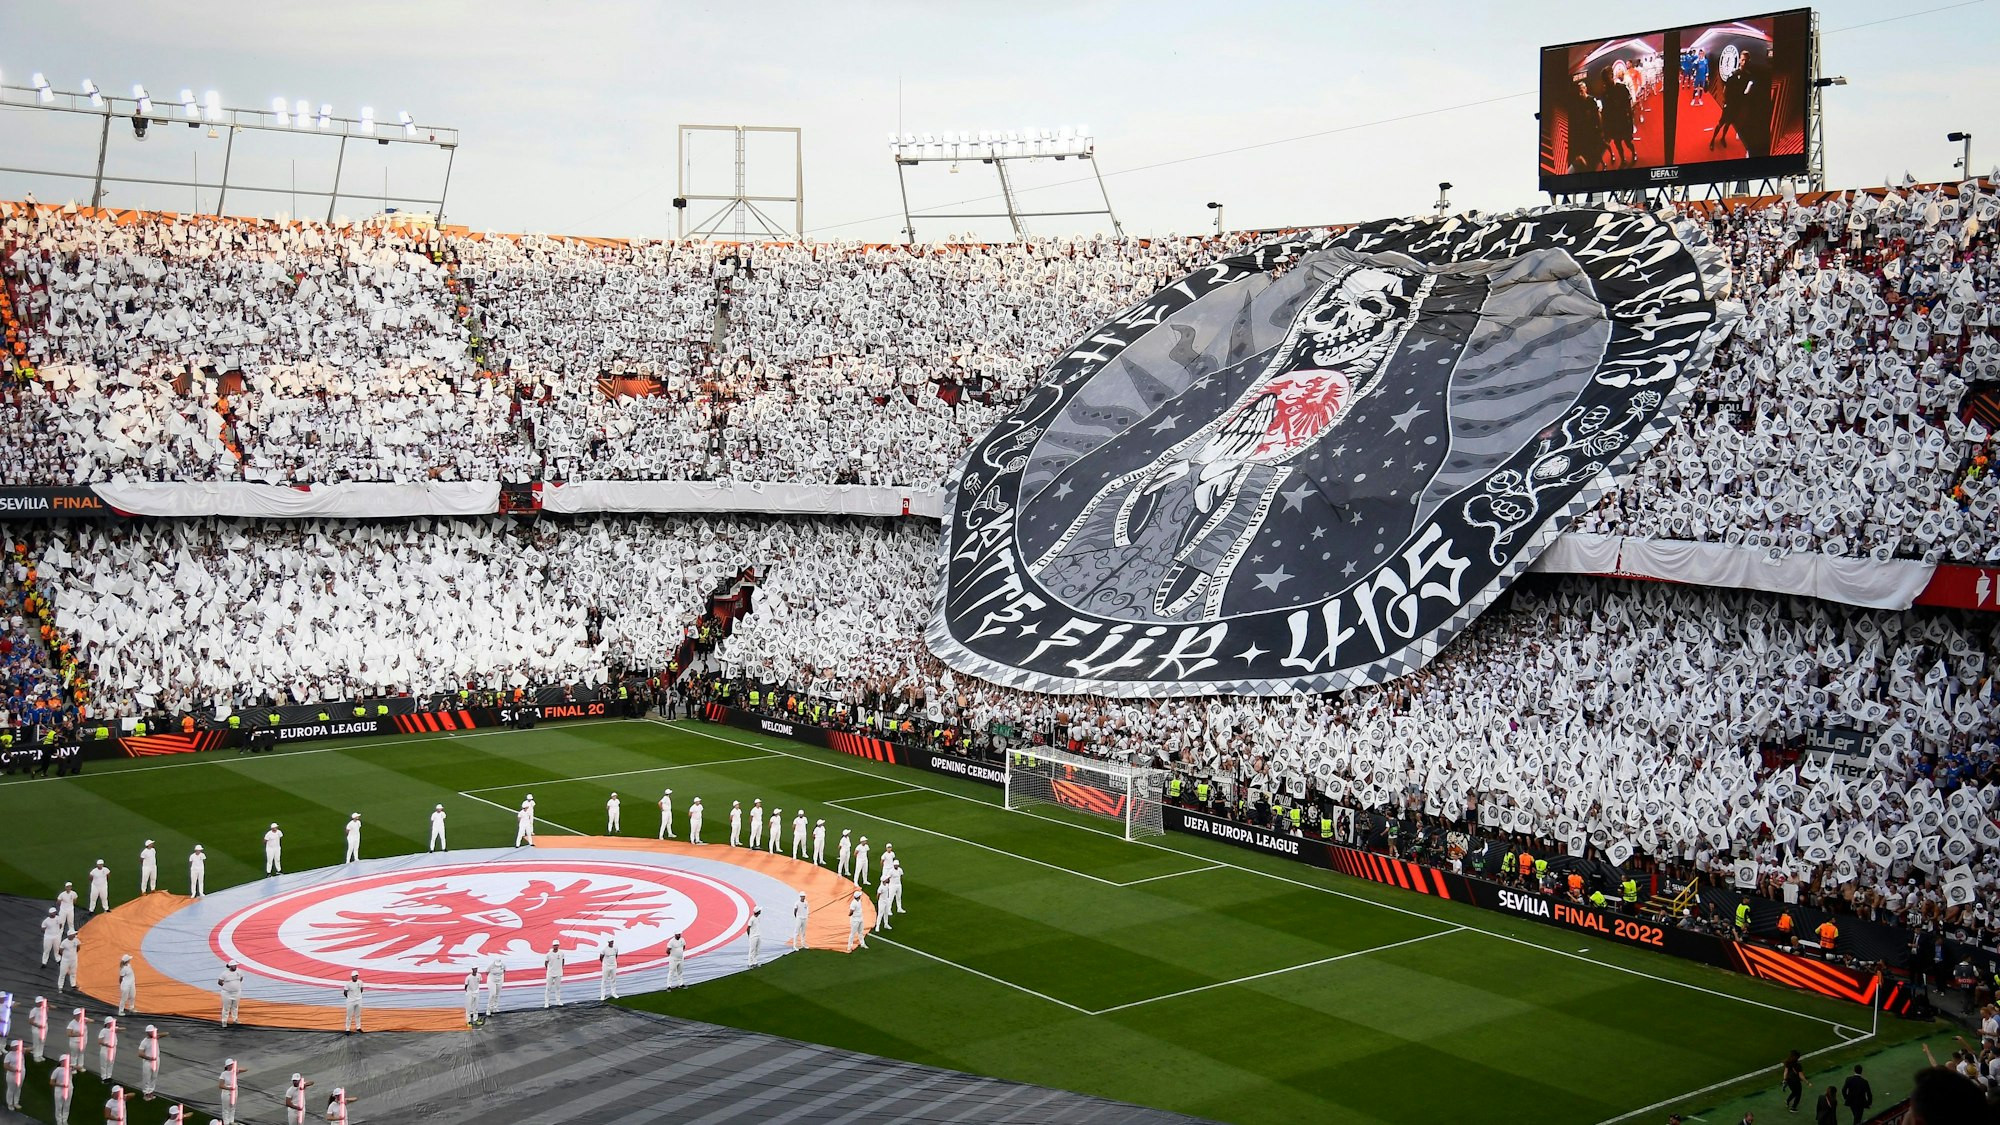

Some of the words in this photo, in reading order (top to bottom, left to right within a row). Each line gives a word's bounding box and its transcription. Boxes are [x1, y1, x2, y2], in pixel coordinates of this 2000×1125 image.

[53, 497, 102, 508] FINAL
[545, 704, 585, 718] FINAL
[280, 725, 328, 739] EUROPA
[331, 721, 377, 735] LEAGUE
[761, 720, 793, 736] WELCOME
[931, 756, 966, 774] OPENING
[1184, 815, 1209, 833] UEFA
[1212, 822, 1253, 843] EUROPA
[1256, 833, 1299, 855] LEAGUE
[1554, 904, 1609, 933] FINAL
[1614, 918, 1664, 946] 2022
